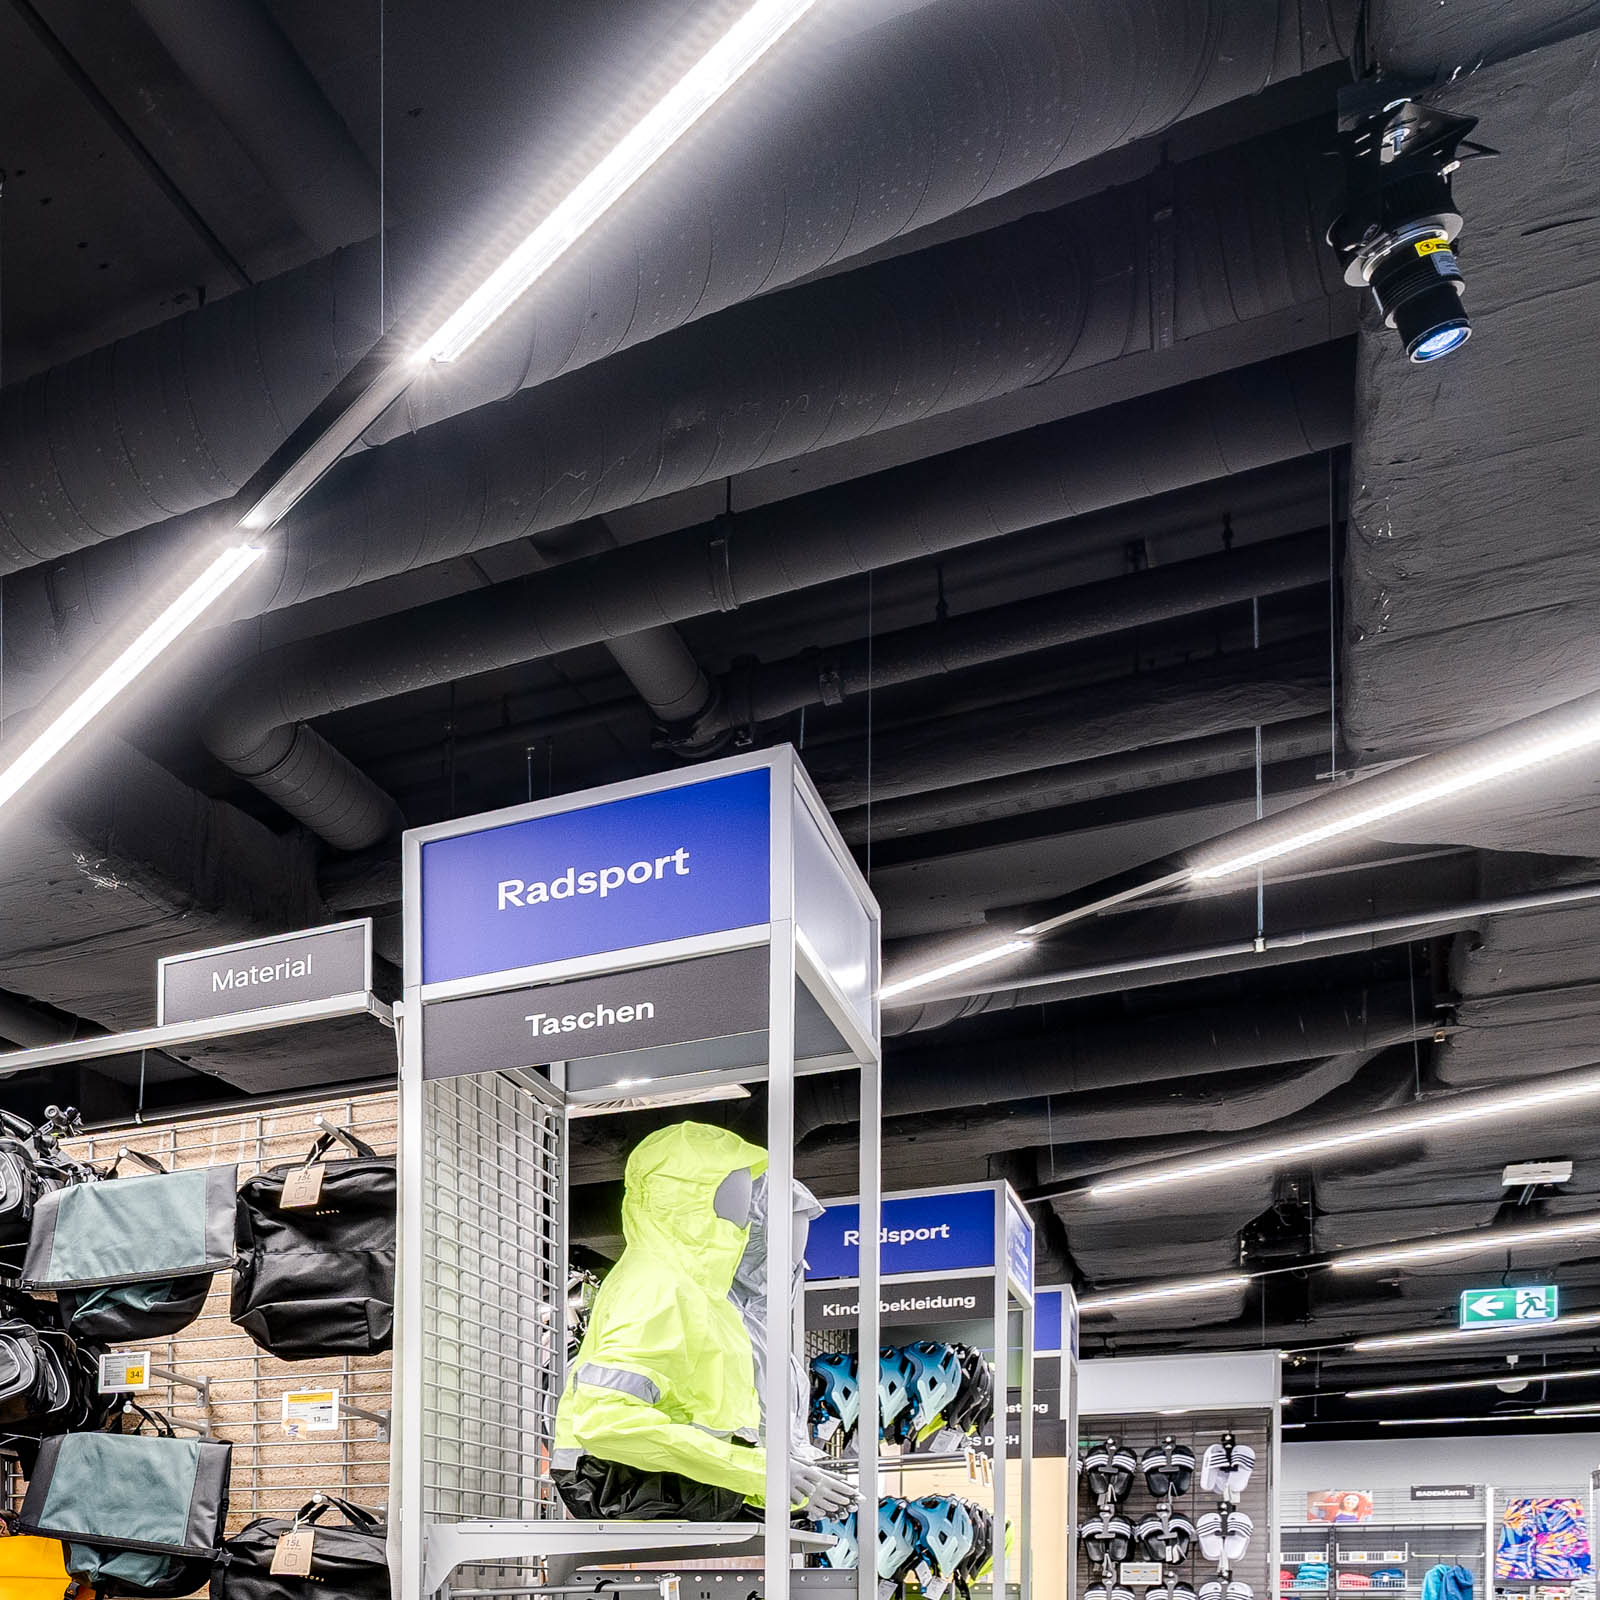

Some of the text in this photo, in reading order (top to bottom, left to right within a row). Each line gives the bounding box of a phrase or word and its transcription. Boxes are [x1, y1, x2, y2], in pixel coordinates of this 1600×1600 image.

[498, 847, 690, 911] Radsport
[212, 954, 312, 992] Material
[525, 1001, 655, 1037] Taschen
[843, 1223, 950, 1246] Rdsport
[823, 1295, 976, 1318] Kindbekleidung
